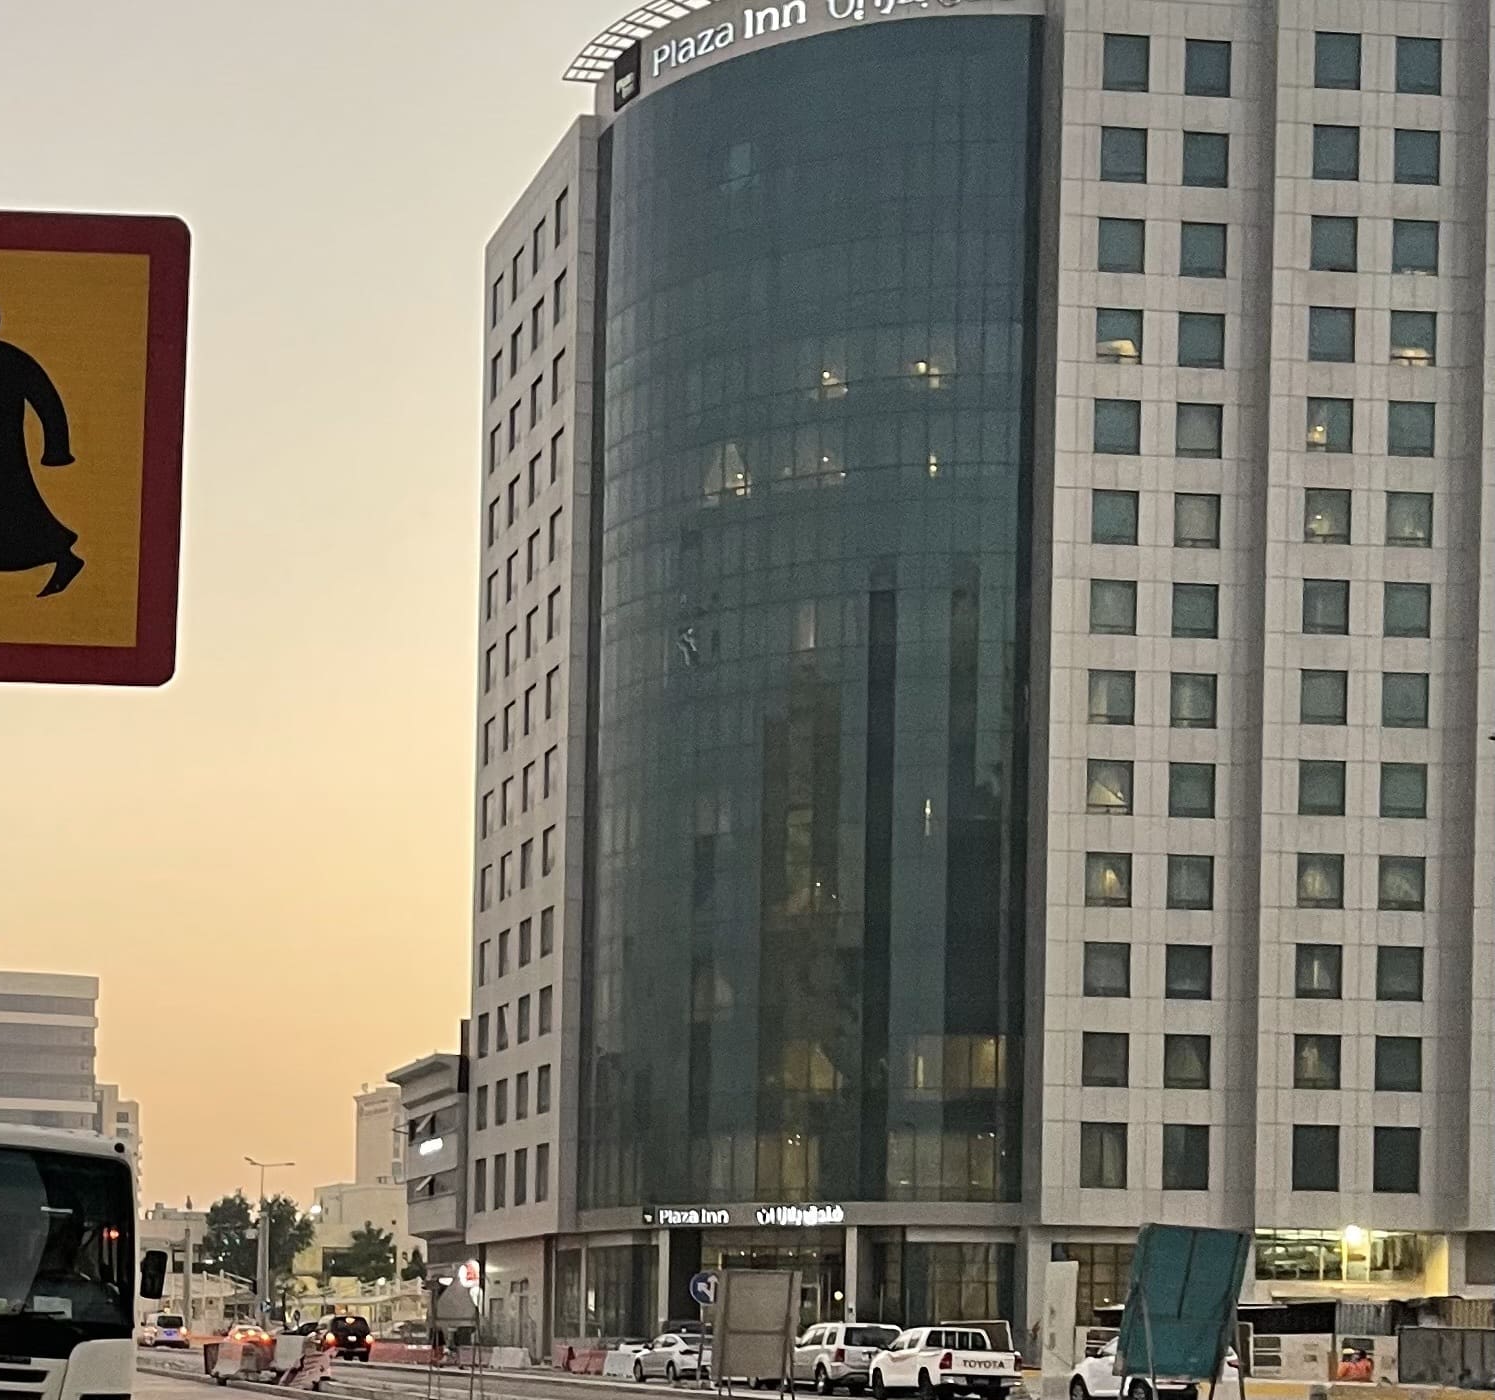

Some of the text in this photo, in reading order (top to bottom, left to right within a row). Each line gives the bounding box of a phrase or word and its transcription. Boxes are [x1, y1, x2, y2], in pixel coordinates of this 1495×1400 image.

[652, 22, 735, 77] Plaza
[744, 0, 807, 39] Inn
[659, 1208, 730, 1225] Plaza Inn
[963, 1360, 1005, 1369] TOYOTA
